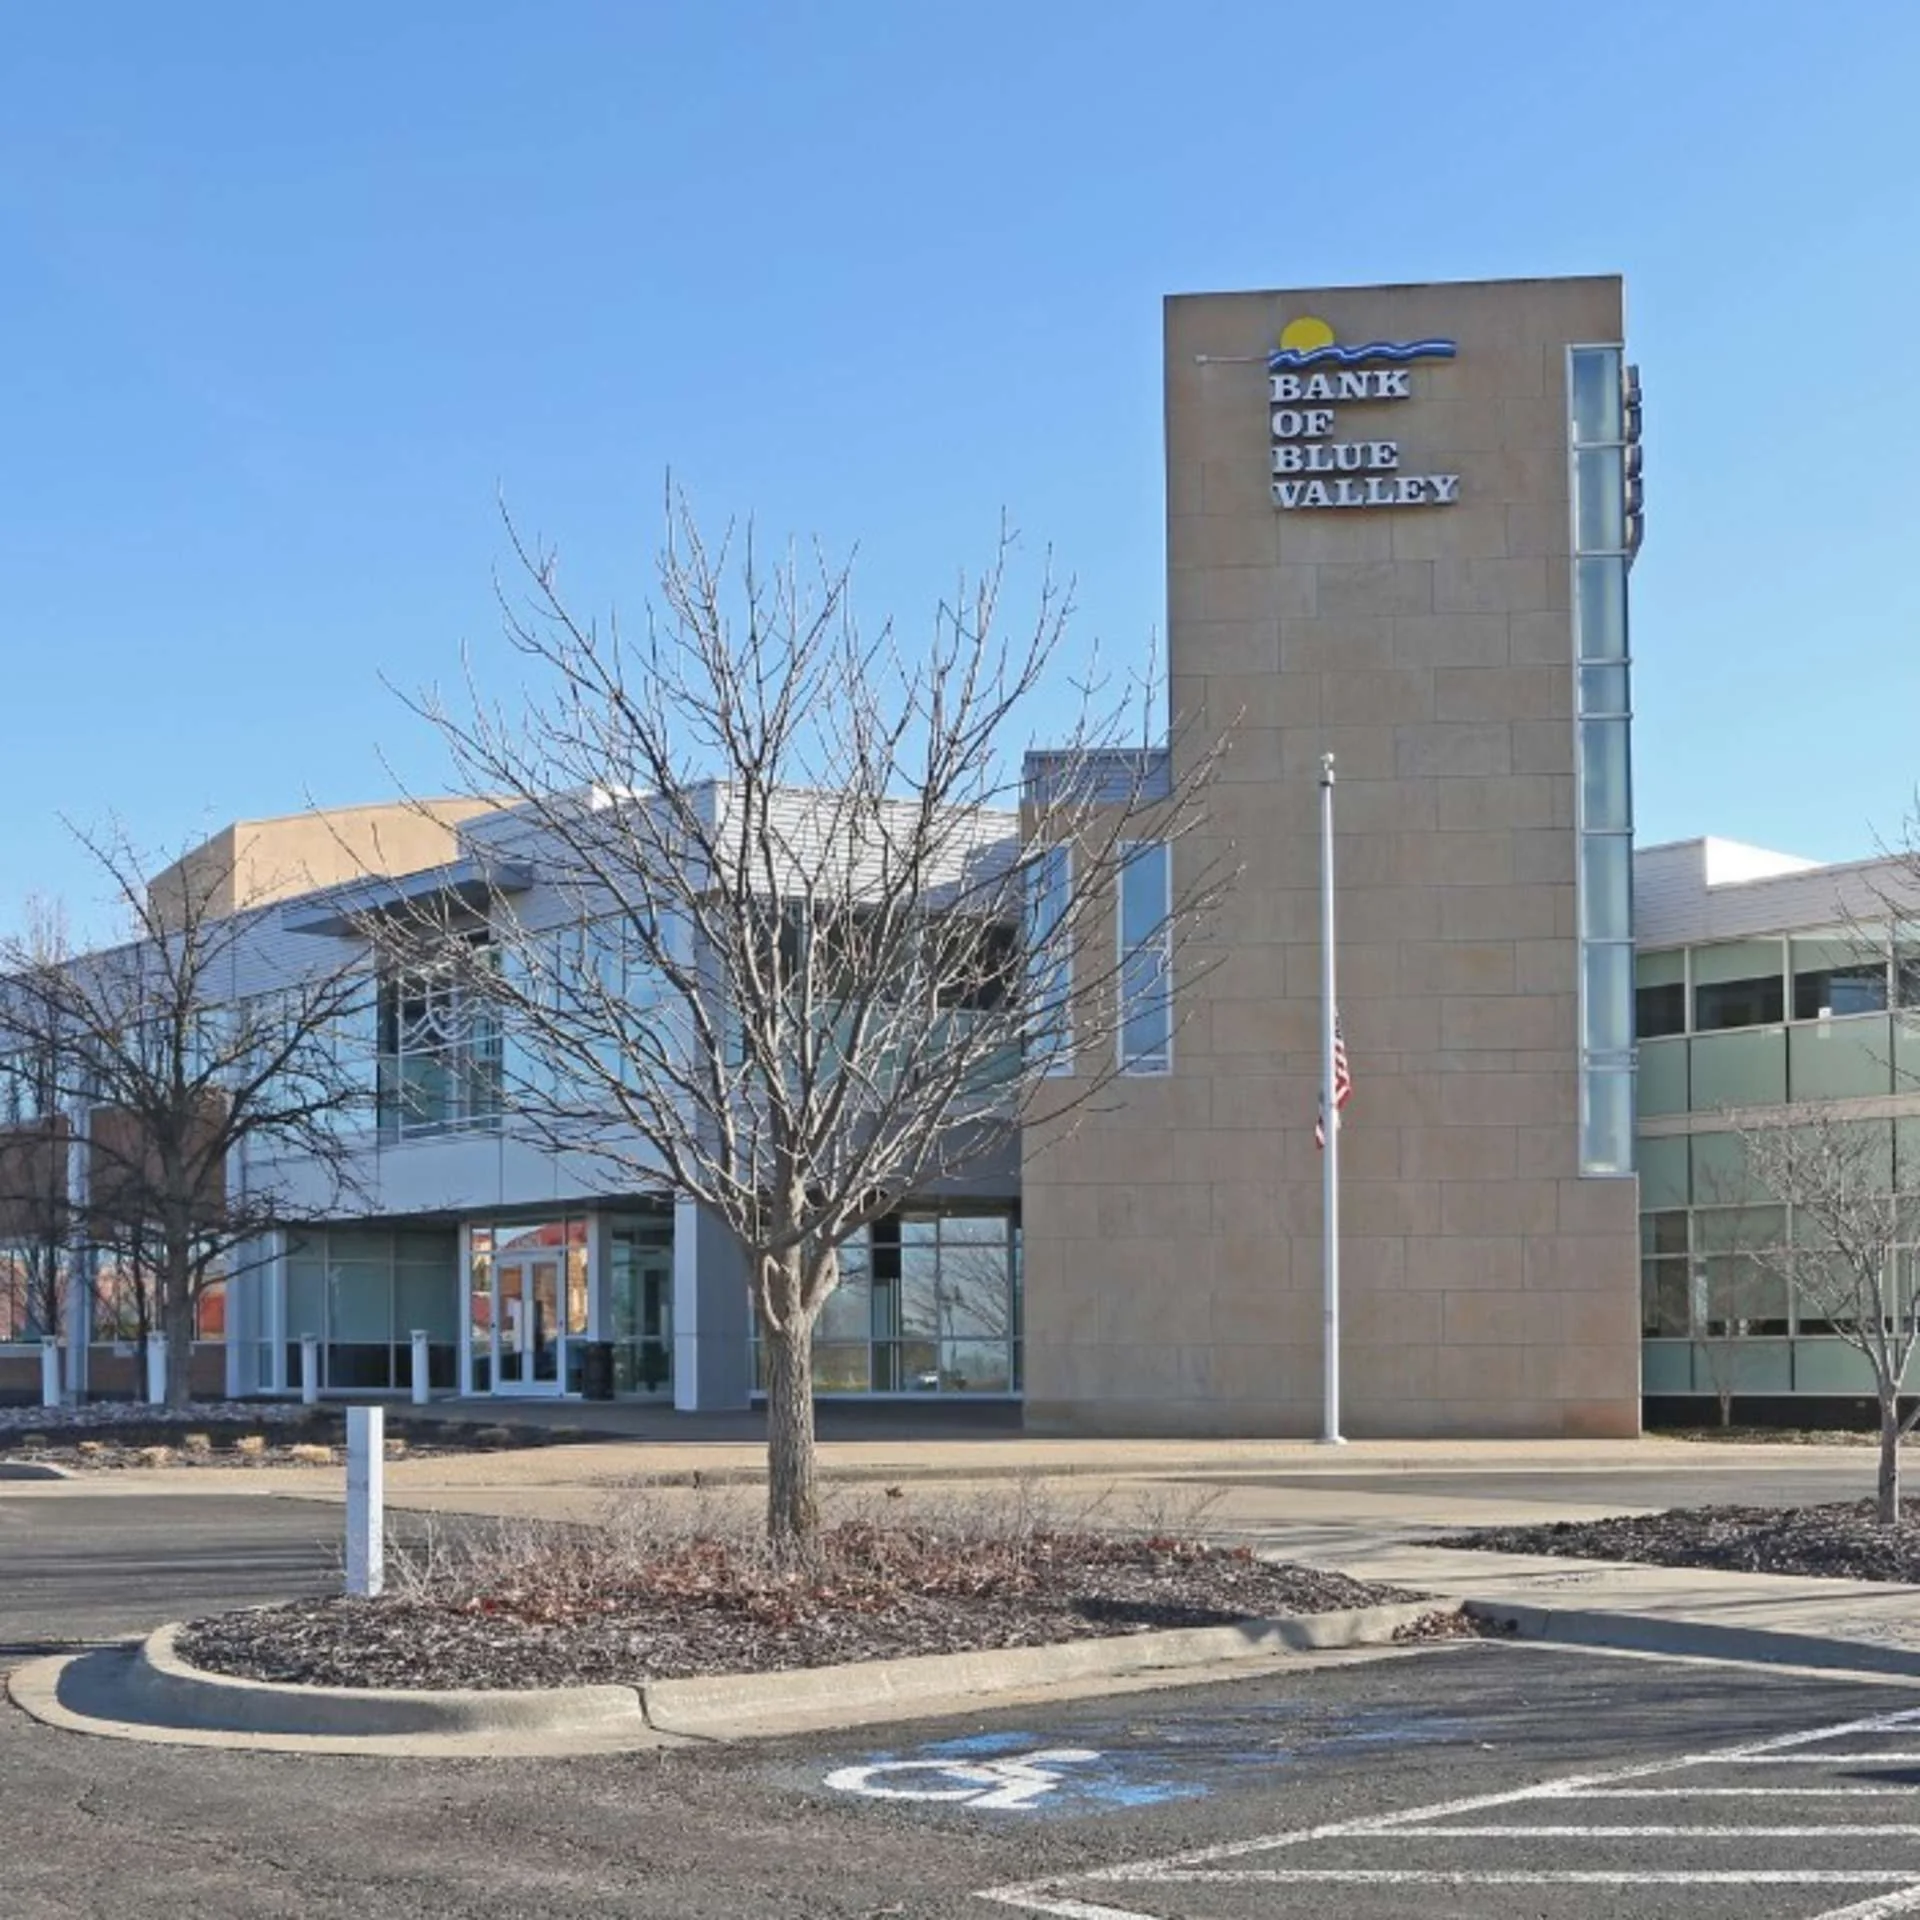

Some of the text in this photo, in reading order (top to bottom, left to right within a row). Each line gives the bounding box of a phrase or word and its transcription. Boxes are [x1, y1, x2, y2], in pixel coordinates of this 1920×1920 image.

[1270, 369, 1410, 402] BANK
[1271, 409, 1335, 439] OF
[1272, 441, 1399, 474] BLUE
[1272, 475, 1460, 508] VALLEY
